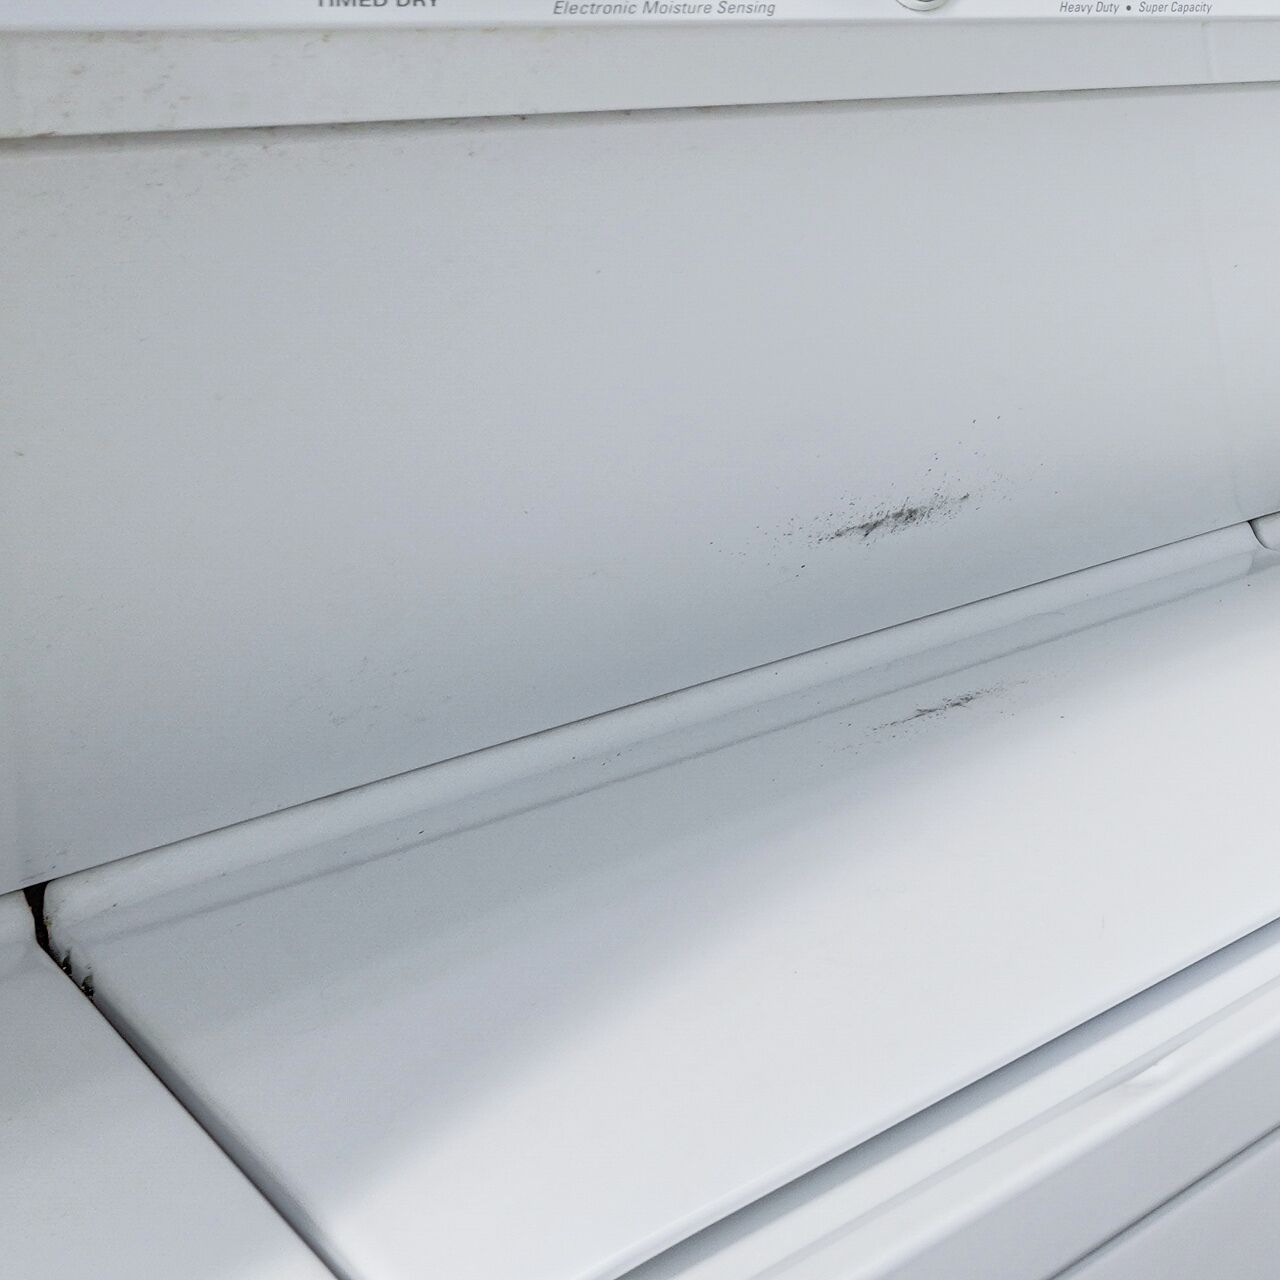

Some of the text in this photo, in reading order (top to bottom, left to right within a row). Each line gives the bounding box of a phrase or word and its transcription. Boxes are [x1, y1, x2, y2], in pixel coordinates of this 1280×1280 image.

[552, 0, 776, 18] Electronic Moisture Sensing
[1059, 0, 1214, 14] Heavy Duty Super Capacity
